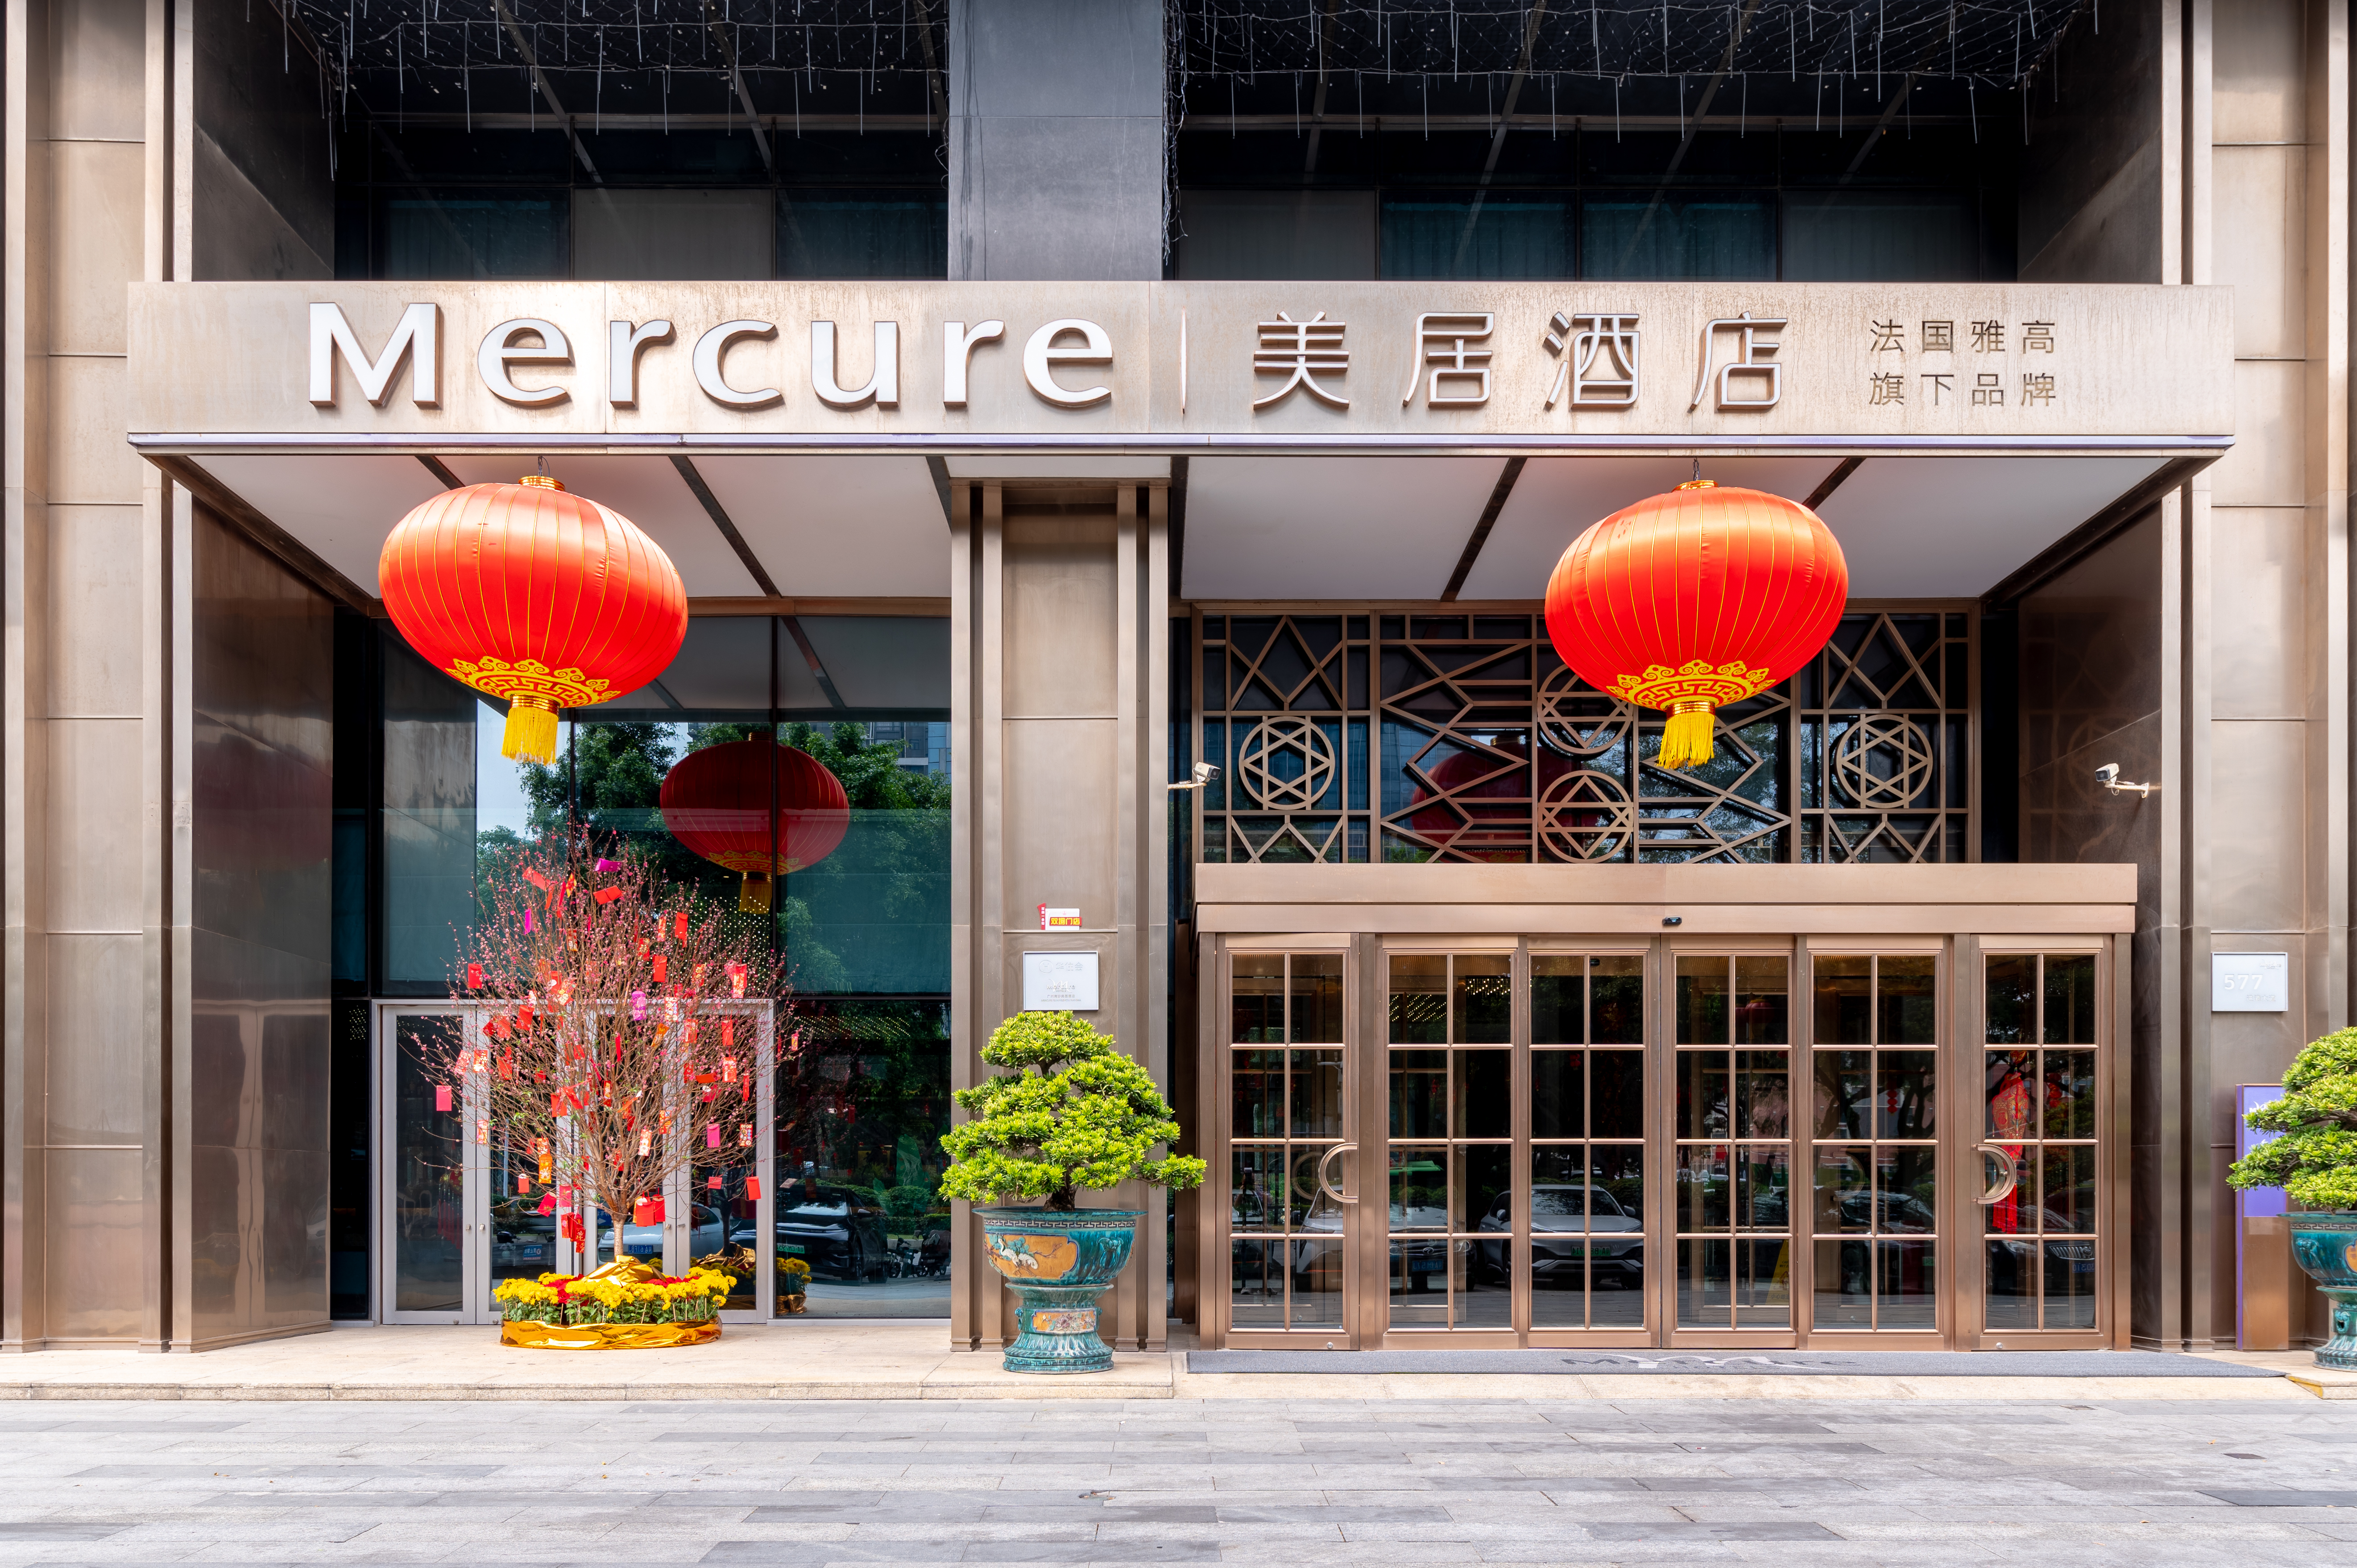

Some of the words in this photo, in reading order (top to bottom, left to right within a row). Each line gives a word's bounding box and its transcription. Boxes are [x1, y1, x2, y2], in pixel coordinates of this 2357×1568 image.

[1869, 319, 2056, 355] 法国雅高
[309, 301, 1114, 410] Mercure
[1253, 311, 1787, 413] 美居酒店
[1869, 372, 2056, 407] 旗下品牌
[1056, 962, 1083, 972] 华住会
[2224, 974, 2263, 990] 577
